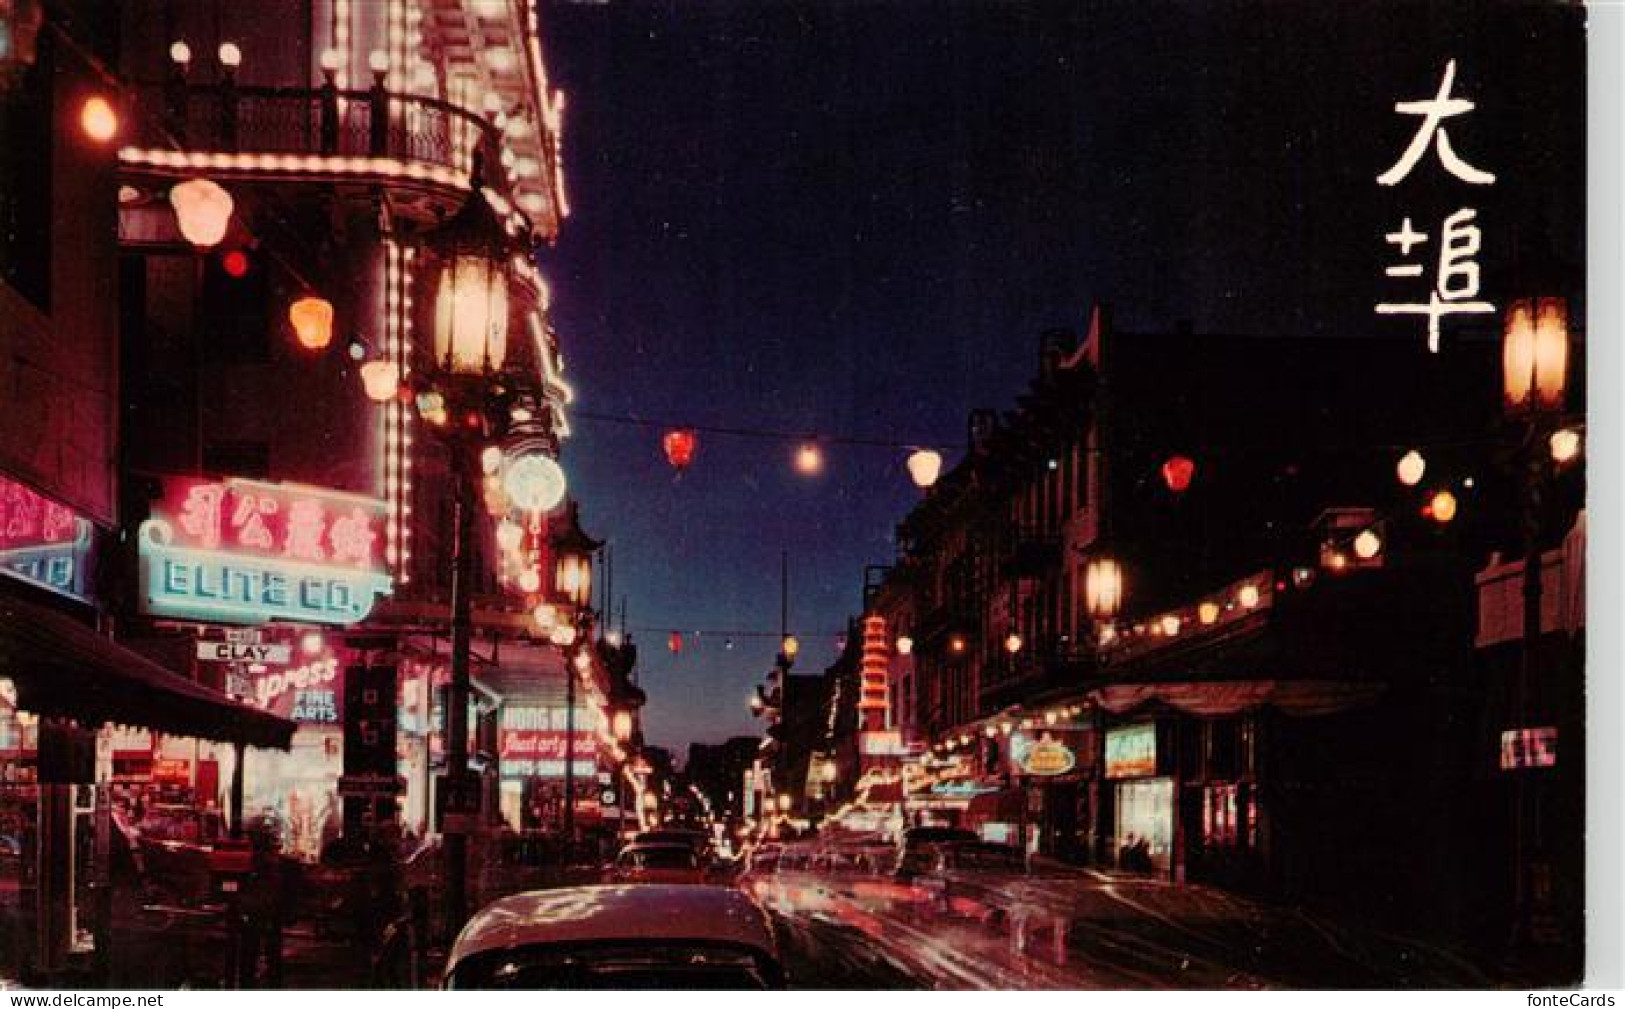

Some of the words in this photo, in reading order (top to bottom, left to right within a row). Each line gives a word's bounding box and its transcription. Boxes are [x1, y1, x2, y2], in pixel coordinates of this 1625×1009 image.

[164, 558, 287, 606] ELITE
[301, 576, 362, 612] CO.
[216, 644, 269, 659] CLAY
[290, 706, 338, 722] ARTS
